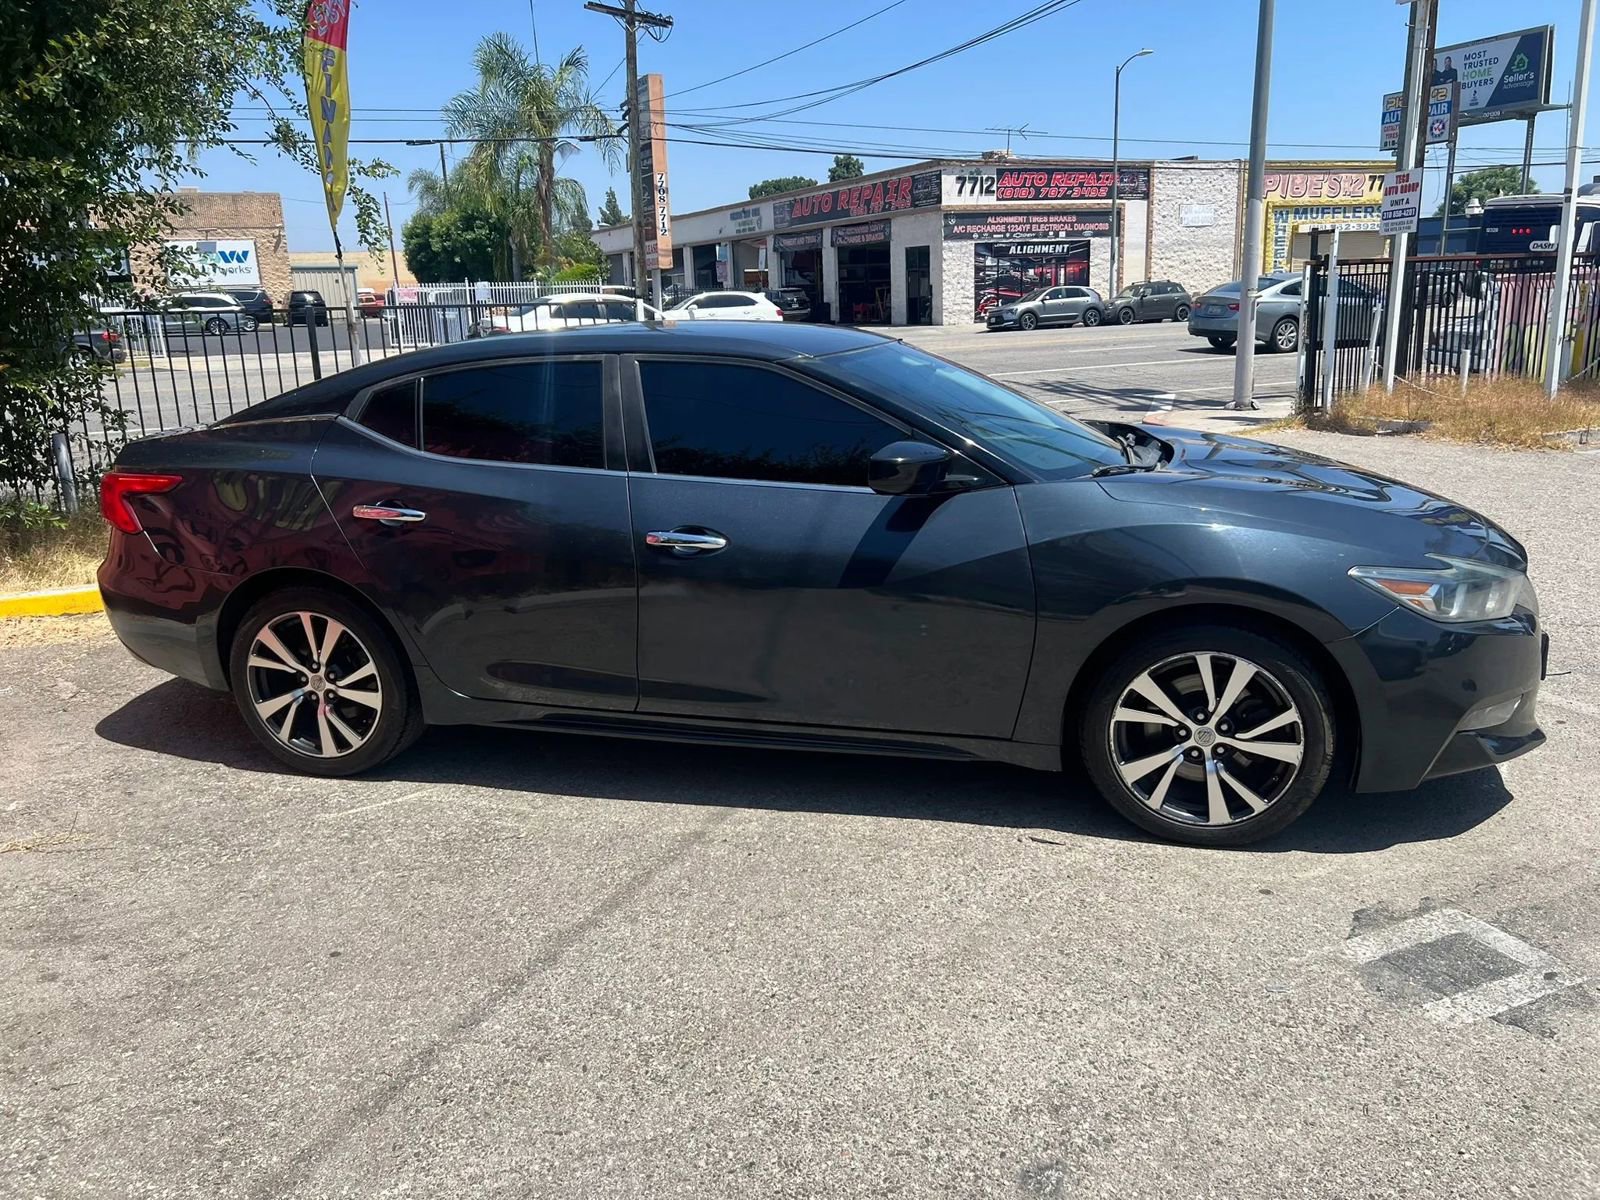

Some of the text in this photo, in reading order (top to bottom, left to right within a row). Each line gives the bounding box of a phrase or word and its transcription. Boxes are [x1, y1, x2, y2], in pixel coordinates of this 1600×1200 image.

[1464, 50, 1487, 61] MOST
[1464, 57, 1499, 70] TRUSTED
[1462, 67, 1493, 80] HOME
[1503, 71, 1535, 83] Seller's
[1461, 77, 1494, 90] BUYERS
[1503, 80, 1535, 90] Advantage
[999, 172, 1047, 187] AUTO
[1052, 172, 1120, 187] REPAIR
[955, 175, 996, 198] 7712
[1384, 182, 1419, 197] AUTO GROUP
[792, 193, 832, 218] AUTO
[837, 176, 912, 211] REPAIR
[997, 187, 1108, 199] (818) 787-3492
[657, 172, 668, 236] 7708 7712
[1390, 199, 1404, 207] UNIT
[987, 216, 1028, 224] ALIGNMENT
[1049, 215, 1077, 223] BRAKES
[953, 222, 1110, 233] A/C RECHARGE 1234YF ELECTRICAL DIAGNOSIS
[1008, 244, 1069, 255] ALIGNMENT
